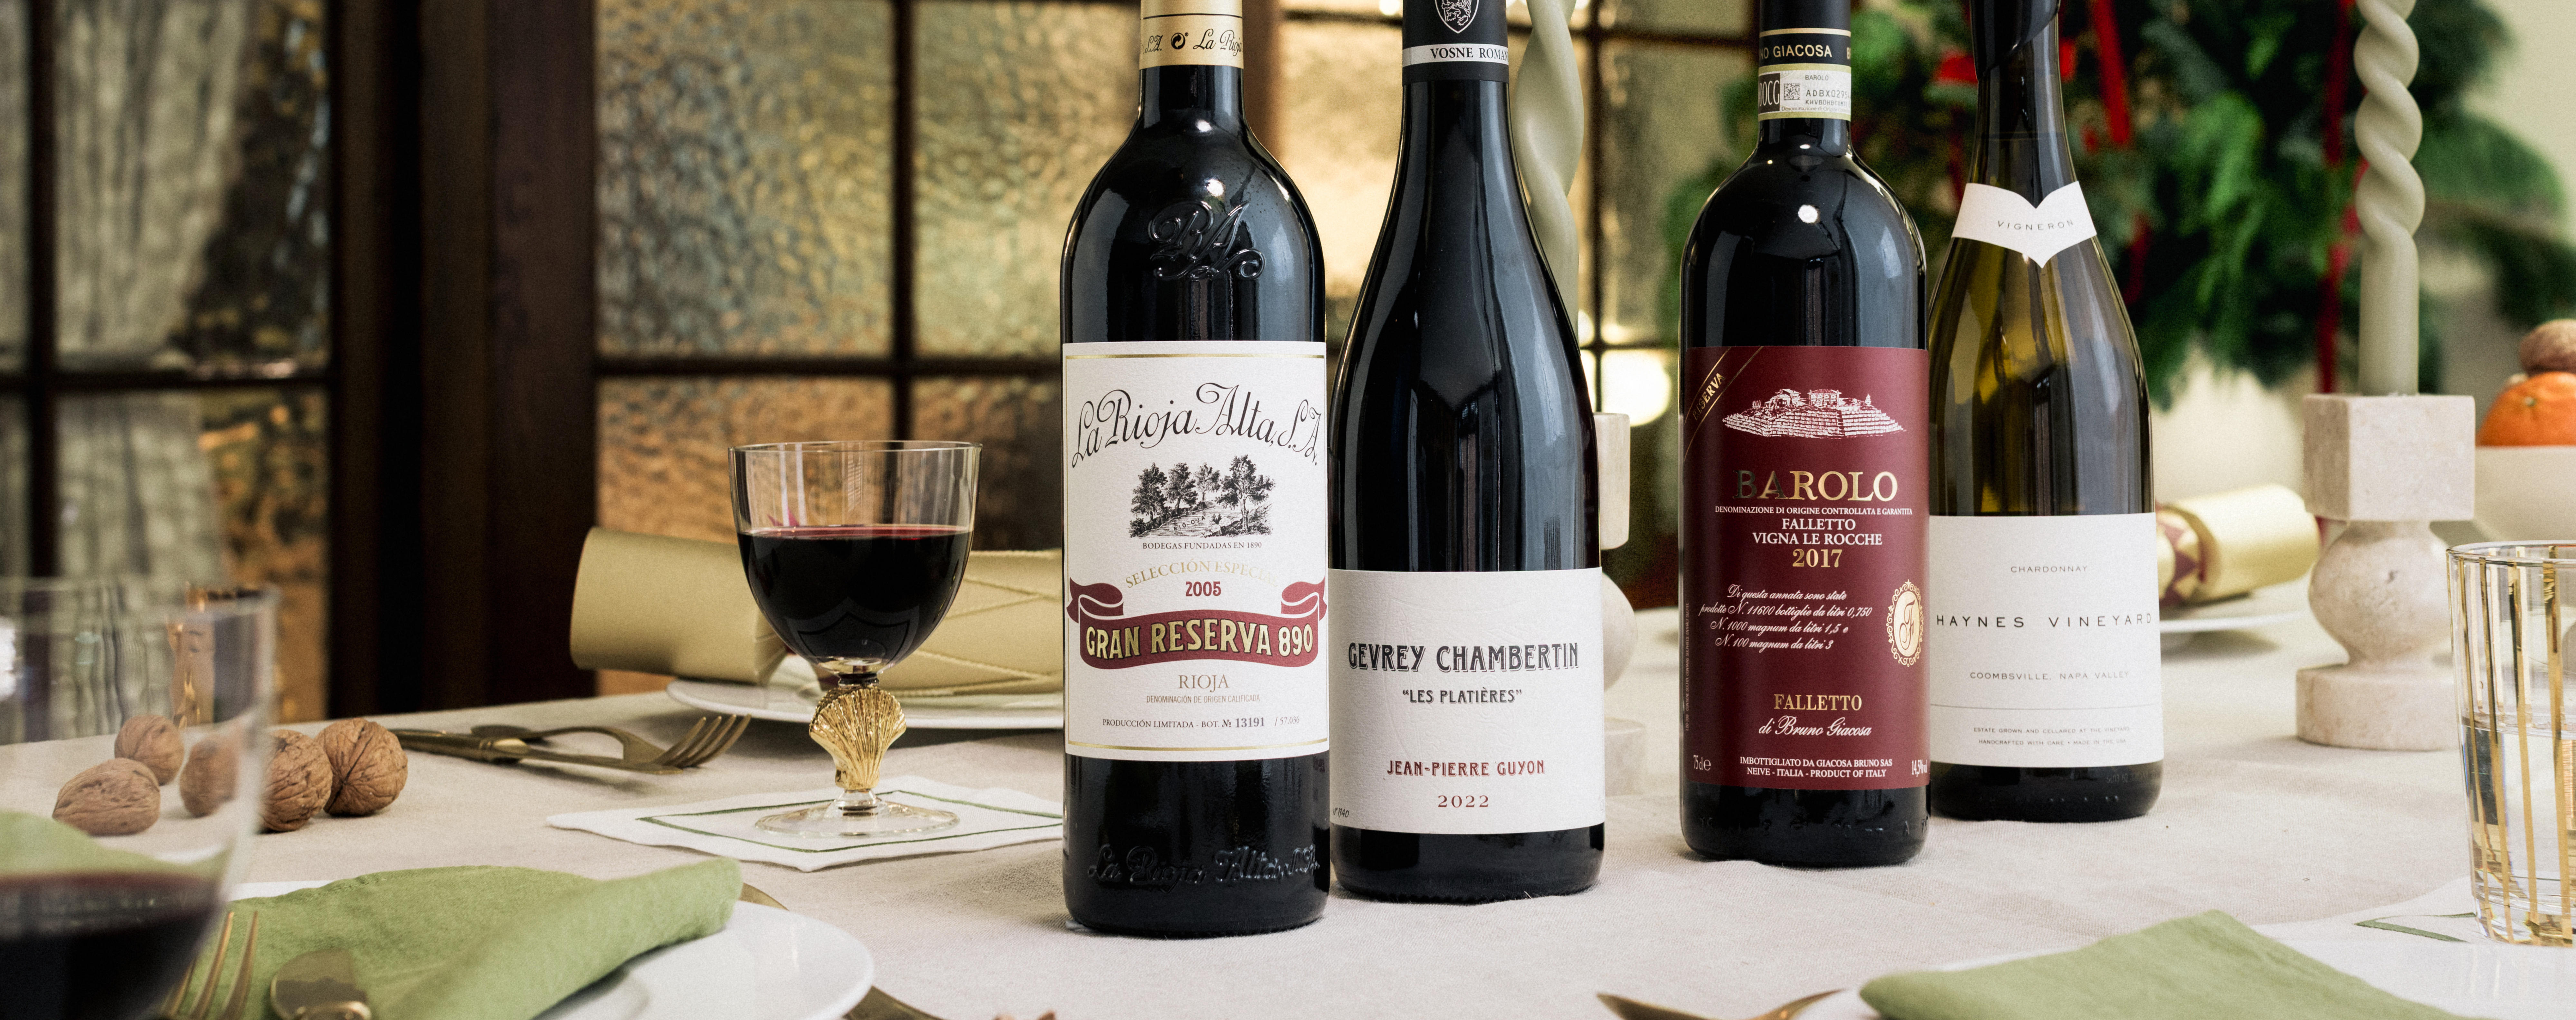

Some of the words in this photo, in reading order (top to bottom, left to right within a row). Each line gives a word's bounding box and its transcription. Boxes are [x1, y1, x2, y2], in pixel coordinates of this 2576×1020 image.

[1193, 28, 1217, 50] La
[1219, 29, 1242, 57] Rioja
[1773, 44, 1833, 58] GIACOSA
[1430, 47, 1474, 59] VOSNE
[1479, 47, 1509, 62] ROMAN
[1997, 220, 2074, 231] VIGNERON
[1692, 372, 1726, 421] RISERVA
[1072, 400, 1102, 468] La
[1096, 389, 1198, 449] Rioja
[1196, 382, 1277, 447] Alta,
[1732, 470, 1898, 502] BAROLO
[1715, 506, 1775, 514] DENOMINAZIONE
[1821, 507, 1876, 515] CONTROLLATA
[1782, 518, 1856, 531] FALLETTO
[1752, 532, 1799, 545] VIGNA
[1803, 533, 1820, 545] LE
[1823, 533, 1883, 546] ROCCHE
[1792, 548, 1843, 568] 2017
[1125, 558, 1211, 589] SELECCIÓN
[1214, 561, 1278, 587] ESPECIAL
[1185, 581, 1221, 597] 2005
[1727, 584, 1743, 598] Di
[1740, 589, 1768, 602] questa
[1769, 590, 1804, 599] annata
[1826, 590, 1847, 600] state
[1698, 602, 1727, 617] prodotte
[1728, 601, 1749, 615] N.
[1747, 605, 1776, 615] 11600
[1775, 604, 1812, 621] bottiglie
[1813, 605, 1826, 616] da
[1826, 605, 1848, 617] litri
[1847, 607, 1873, 618] 0,750
[1710, 617, 1729, 630] N.
[1727, 621, 1748, 631] 1000
[1747, 624, 1788, 637] magnum
[1789, 621, 1802, 632] da
[1803, 621, 1825, 633] litri
[1824, 623, 1842, 635] 1,5
[1936, 614, 2025, 628] HAYNES
[2048, 613, 2152, 628] VINEYARD
[1086, 625, 1141, 660] GRAN
[1151, 618, 1273, 656] RESERVA
[1278, 623, 1313, 657] 890
[1715, 634, 1734, 647] N.
[1733, 638, 1749, 647] 100
[1748, 641, 1789, 653] magnum
[1790, 637, 1804, 649] da
[1804, 637, 1826, 649] litri
[1825, 640, 1834, 650] 3
[1348, 642, 1426, 672] GEVREY
[1436, 642, 1579, 673] CHAMBERTIN
[1178, 673, 1229, 692] RIOJA
[2094, 671, 2130, 679] VALLEY
[1146, 694, 1192, 703] DENOMINACIÓN
[1228, 694, 1260, 703] CALIFICADA
[1402, 689, 1434, 704] “LES
[1439, 687, 1522, 704] PLATIÈRES”
[1774, 694, 1862, 711] FALLETTO
[1102, 718, 1151, 728] PRODUCCIÓN
[1235, 717, 1265, 728] 13191
[1280, 715, 1300, 725] 57.036
[1758, 718, 1775, 734] di
[1775, 715, 1824, 736] Bruno
[1826, 717, 1872, 736] Giacosa
[1387, 759, 1490, 777] JEAN-PIERRE
[1497, 759, 1546, 777] GUYON
[1739, 756, 1801, 767] IMBOTTIGLIATO
[1816, 759, 1852, 767] GIACOSA
[1853, 759, 1880, 767] BRUNO
[1880, 758, 1893, 767] SAS
[1747, 767, 1771, 776] NEIVE
[1776, 768, 1804, 777] ITALIA
[1810, 769, 1851, 777] PRODUCT
[1865, 769, 1887, 777] ITALY
[1438, 795, 1489, 808] 2022
[1087, 843, 1123, 881] La
